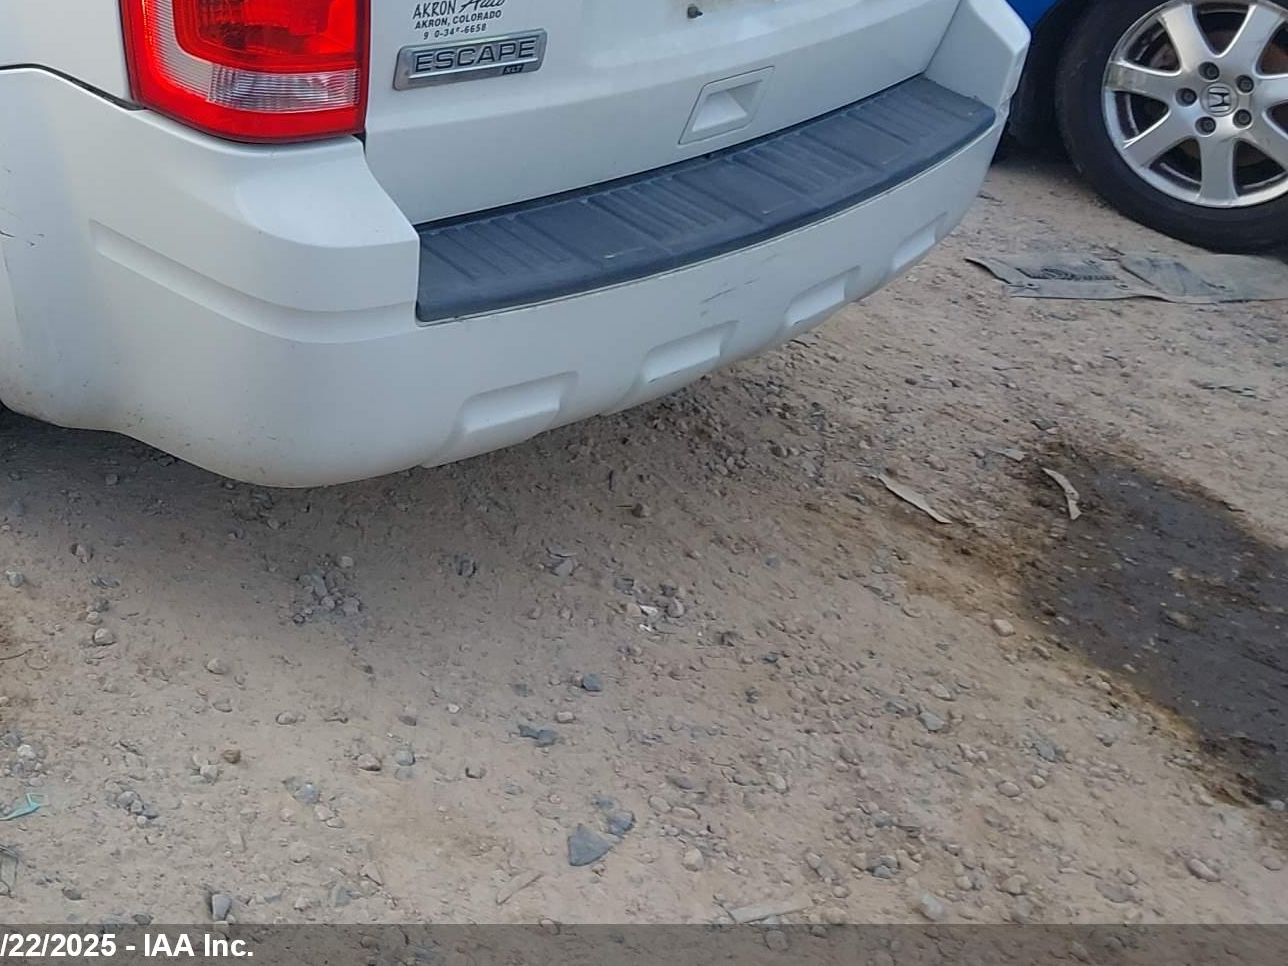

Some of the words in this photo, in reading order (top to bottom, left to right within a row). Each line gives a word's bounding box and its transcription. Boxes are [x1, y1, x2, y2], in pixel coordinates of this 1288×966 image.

[415, 17, 451, 30] AKRON,
[452, 10, 502, 24] COLORADO
[415, 39, 536, 72] ESCAPE
